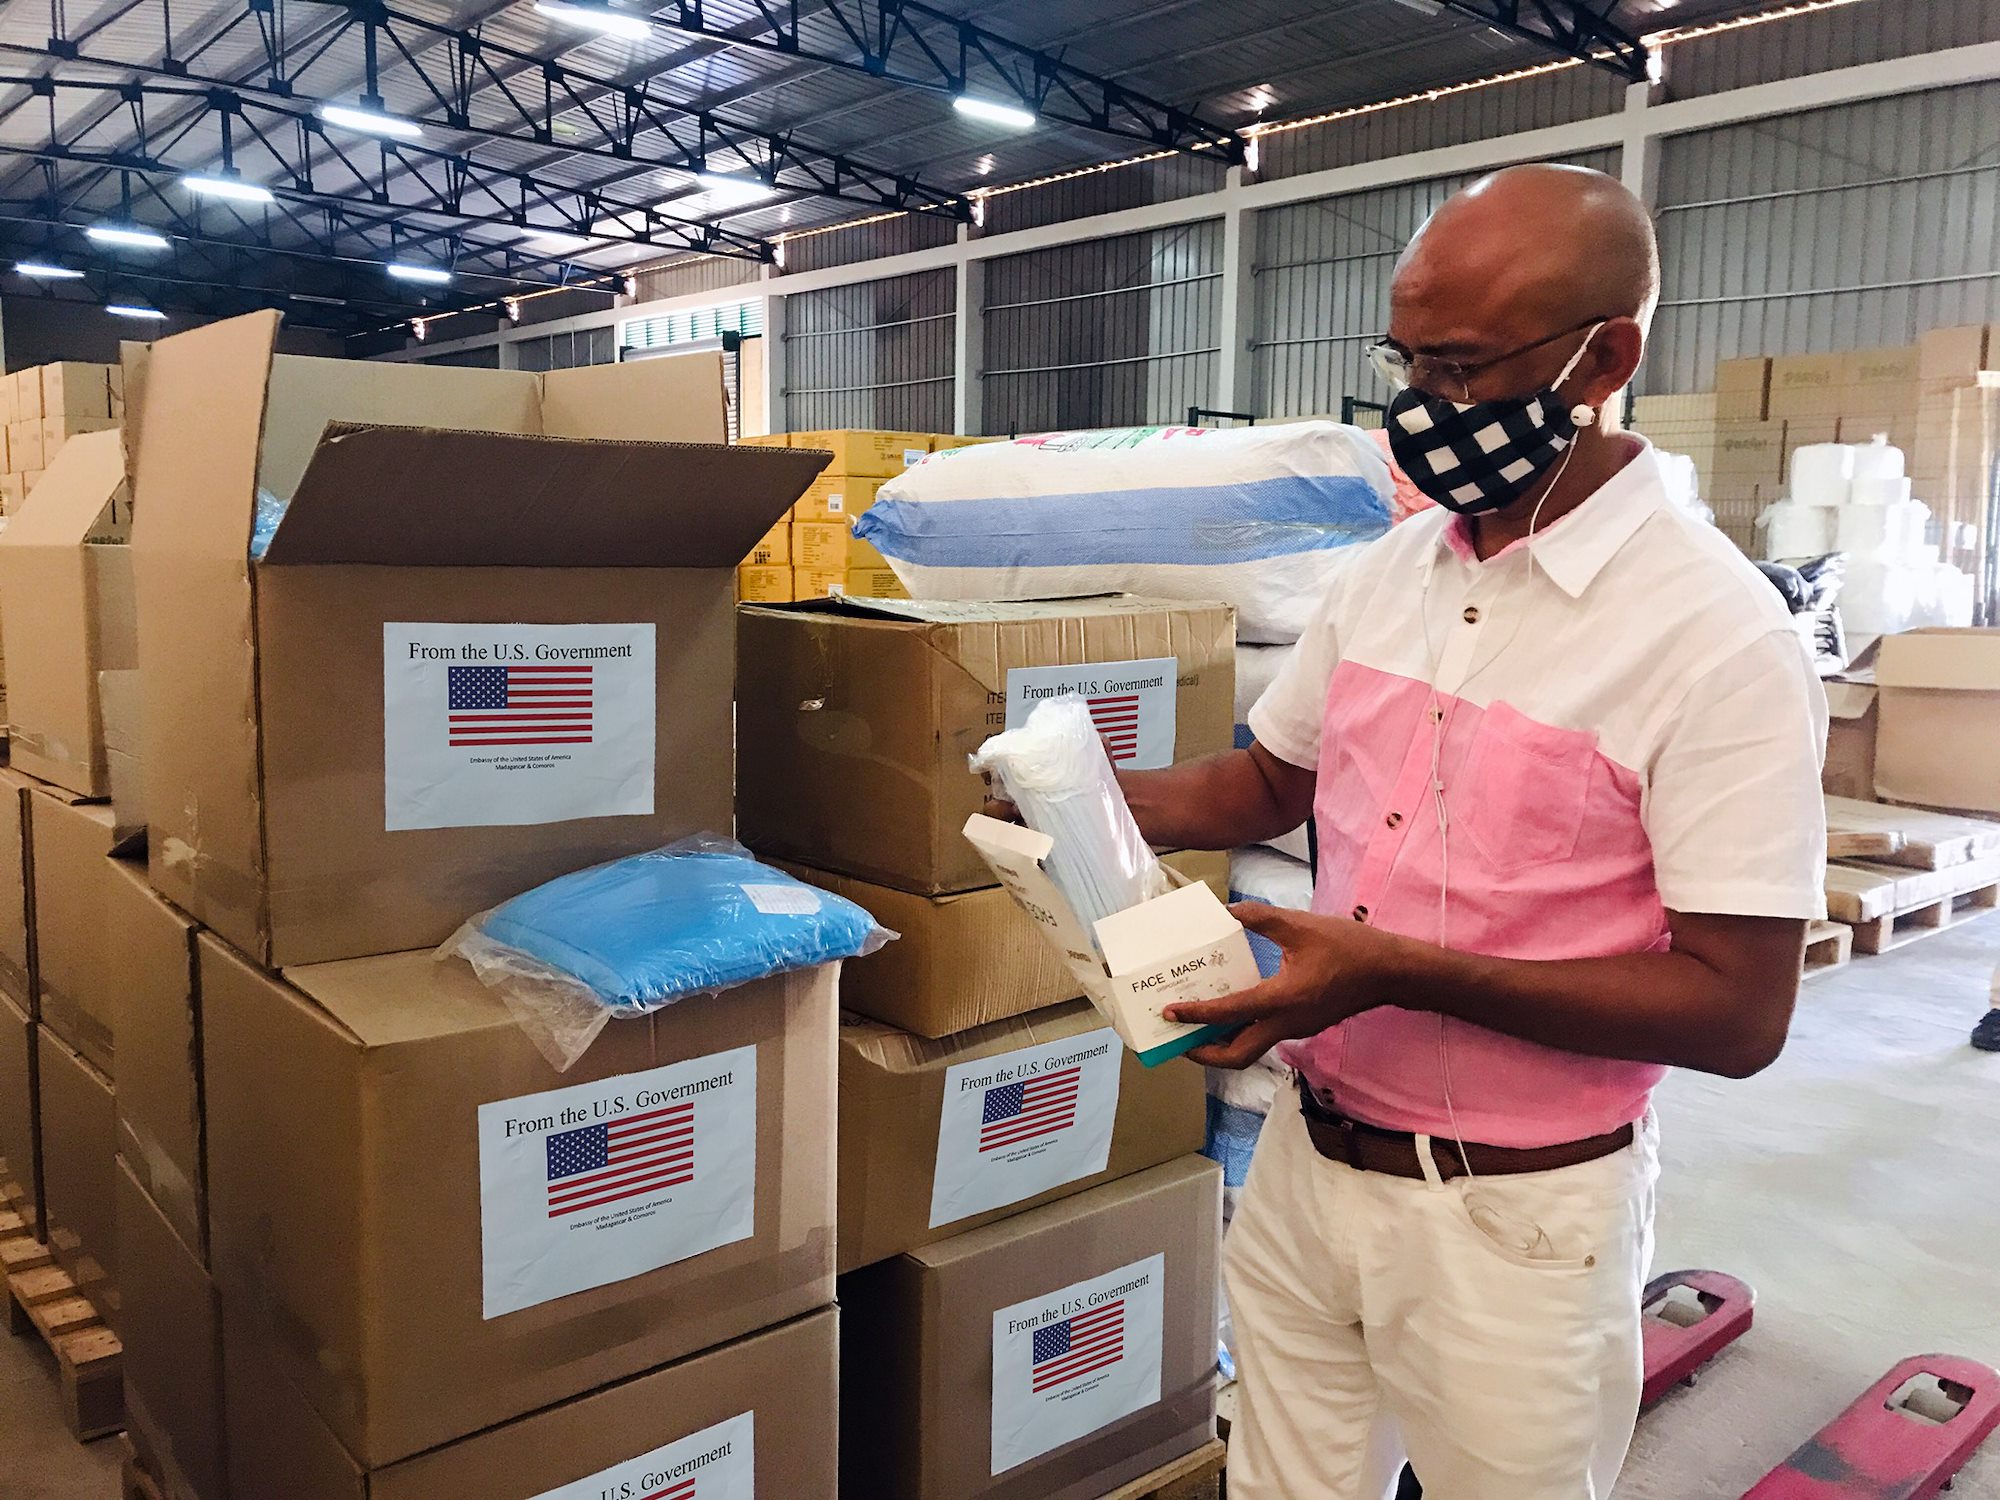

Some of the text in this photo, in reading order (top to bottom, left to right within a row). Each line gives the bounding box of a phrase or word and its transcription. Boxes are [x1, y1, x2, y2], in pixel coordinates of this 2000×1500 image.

[408, 642, 632, 660] From the U.S. Government
[1023, 685, 1053, 699] From
[1078, 681, 1100, 695] U.S.
[1104, 676, 1163, 693] Government
[1132, 973, 1165, 992] FACE
[1170, 957, 1206, 978] MASK
[961, 1043, 1109, 1091] From the U.S. Government
[505, 1071, 733, 1138] From the U.S. Government
[570, 1219, 593, 1230] Embassy
[611, 1210, 628, 1220] United
[629, 1206, 644, 1214] States
[652, 1198, 672, 1208] America
[595, 1218, 627, 1231] Madagascar
[633, 1210, 656, 1221] Comoros
[1008, 1274, 1149, 1334] From the U.S. Government
[641, 1441, 732, 1491] Government
